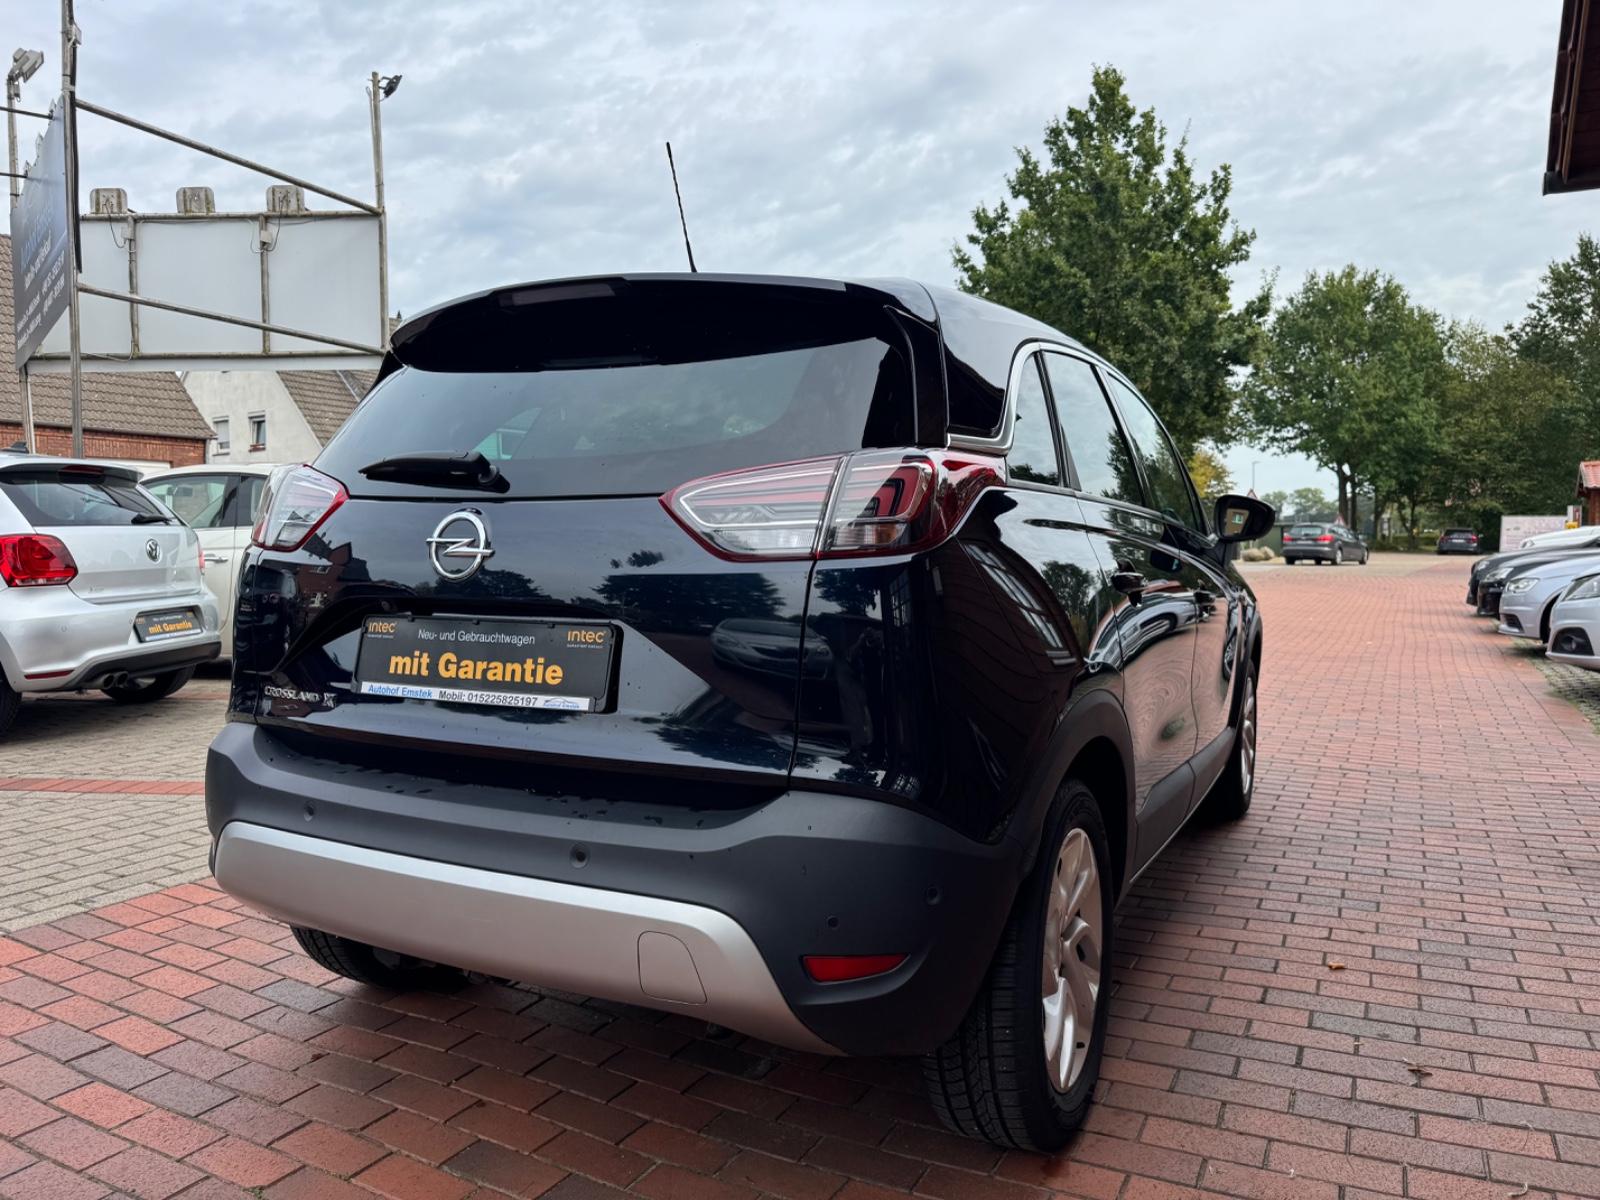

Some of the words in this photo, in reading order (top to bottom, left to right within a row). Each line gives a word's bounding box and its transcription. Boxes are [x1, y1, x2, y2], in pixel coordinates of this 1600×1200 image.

[148, 624, 162, 634] mit
[417, 628, 438, 640] Neu-
[440, 630, 455, 641] und
[457, 630, 536, 646] Gebrauchtwagen
[567, 629, 605, 643] intec
[388, 651, 430, 676] mit
[438, 652, 564, 685] Garantie
[368, 684, 400, 695] Autohof
[401, 686, 433, 698] Emstek
[438, 690, 466, 701] Mobil:
[467, 692, 538, 707] 015225825197
